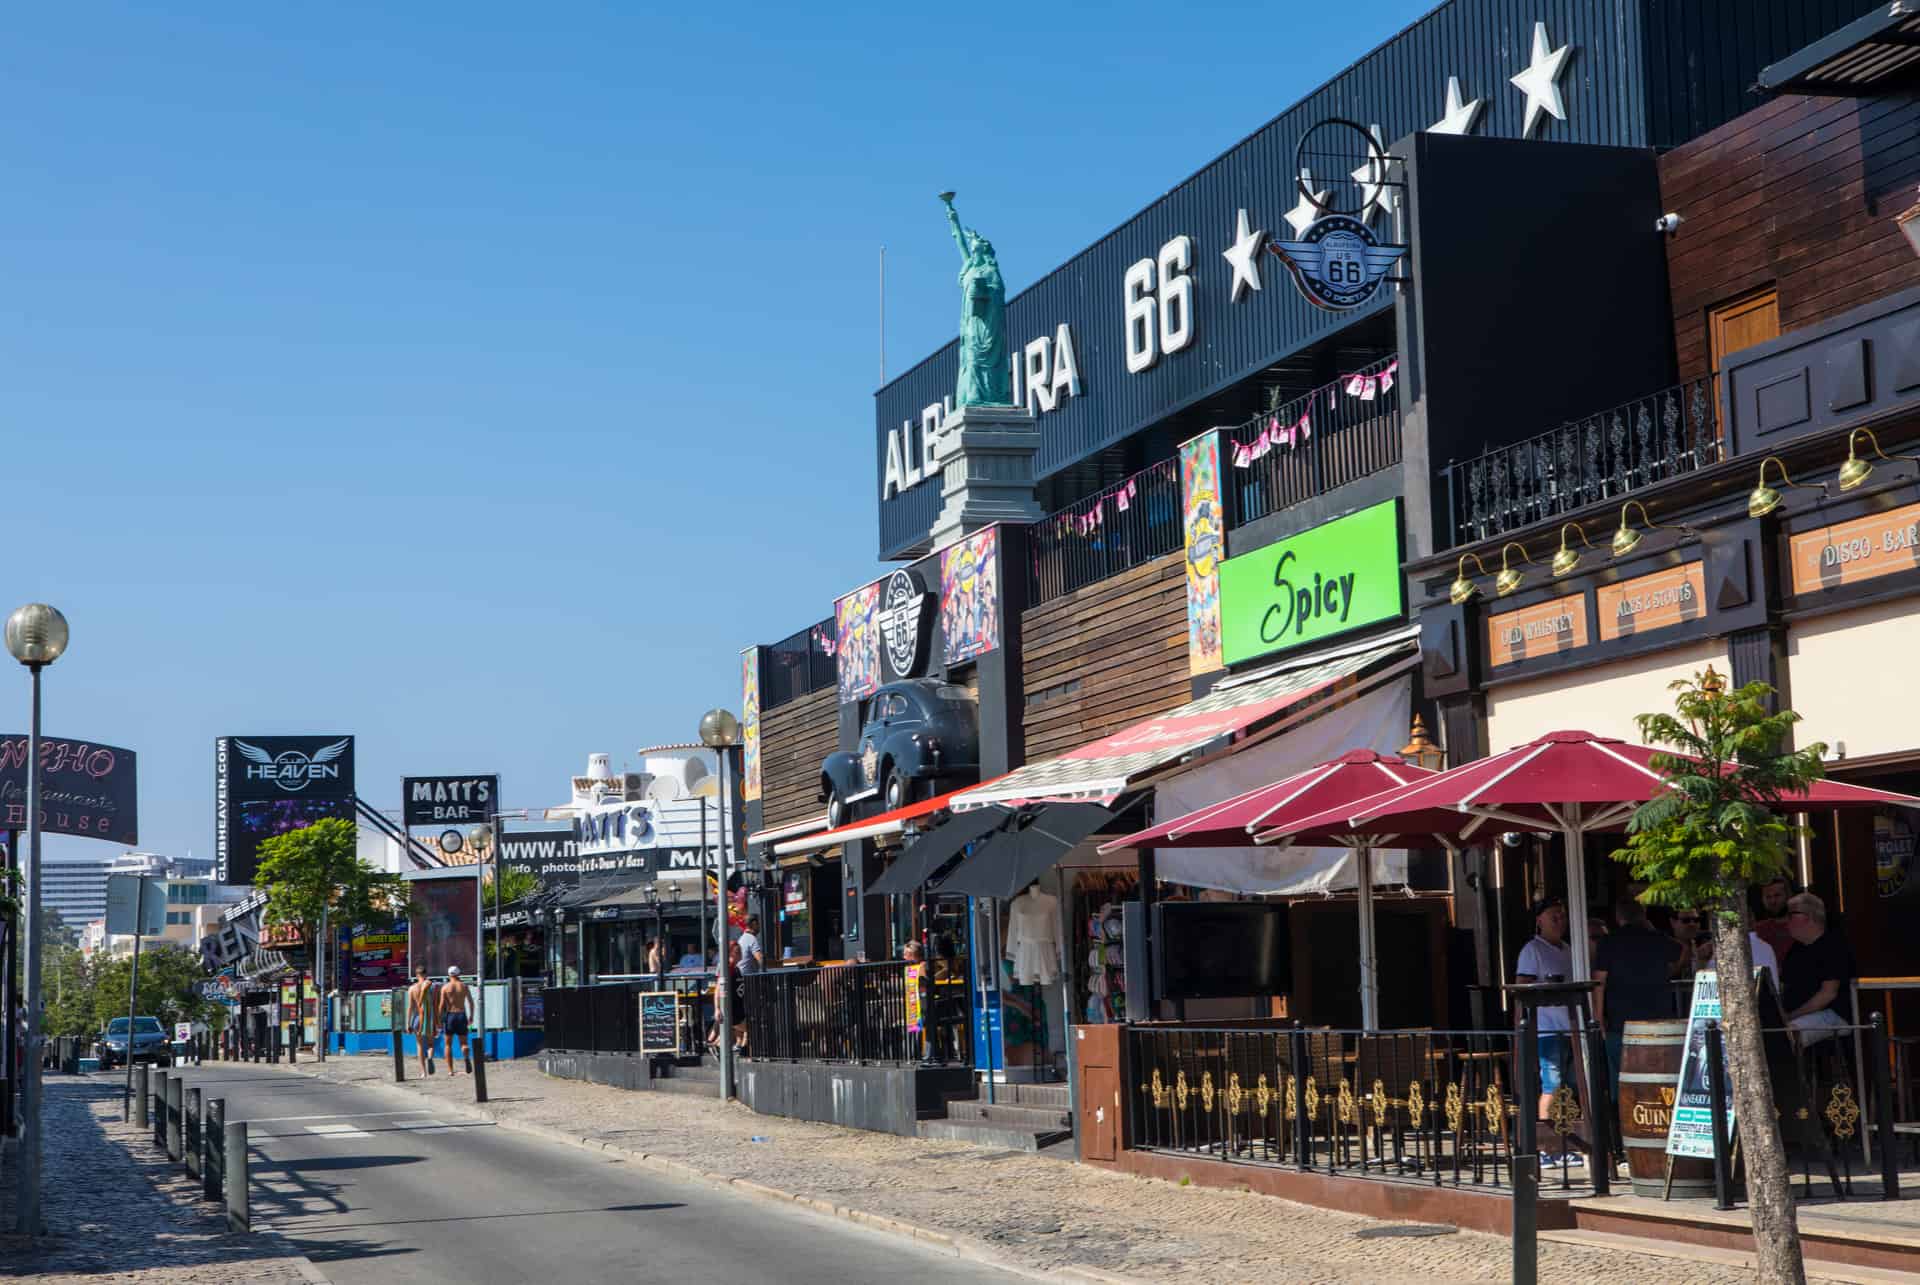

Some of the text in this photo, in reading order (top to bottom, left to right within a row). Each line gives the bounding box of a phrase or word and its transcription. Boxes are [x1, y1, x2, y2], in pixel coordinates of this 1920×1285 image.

[1329, 260, 1360, 284] 66
[1124, 235, 1194, 374] 66
[1824, 536, 1872, 567] DISCO
[1883, 523, 1919, 553] BAR
[1260, 550, 1354, 644] Spicy
[896, 620, 908, 647] 66
[1525, 611, 1575, 641] WHISKEY
[247, 764, 339, 779] HEAVEN
[412, 779, 489, 803] MATT'S
[217, 739, 227, 882] CLUBHEAVEN.COM
[434, 805, 471, 819] BAR
